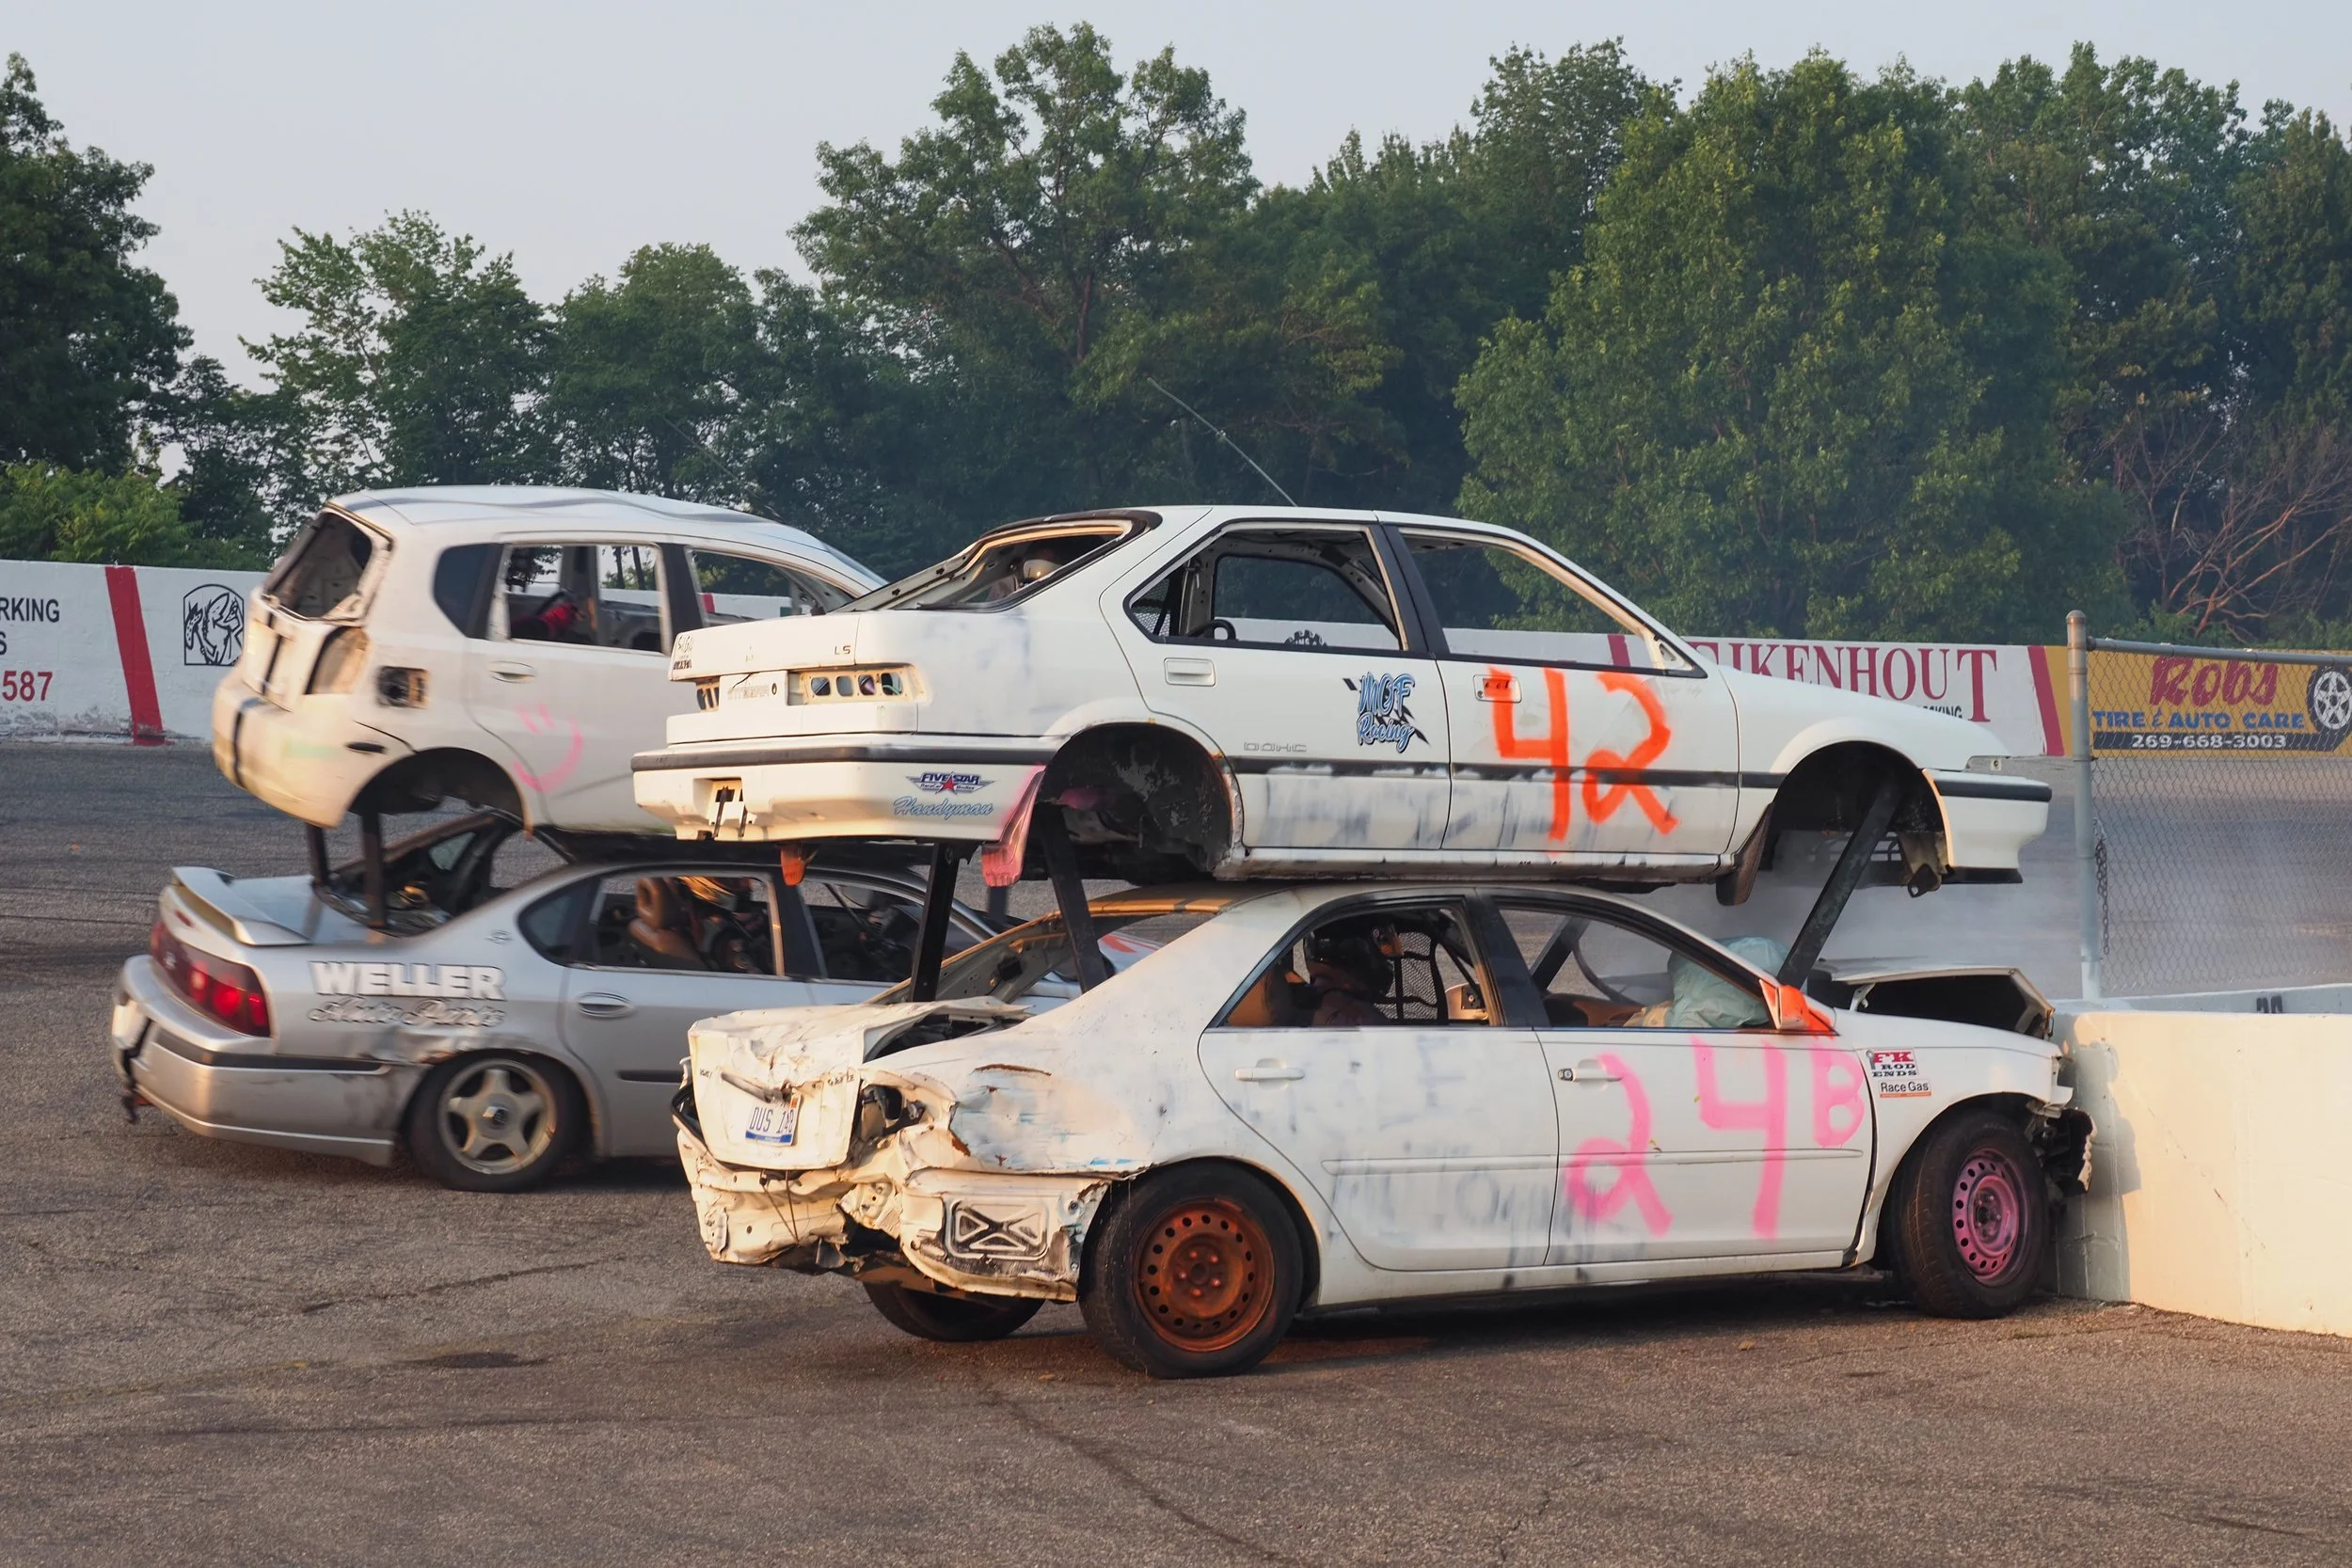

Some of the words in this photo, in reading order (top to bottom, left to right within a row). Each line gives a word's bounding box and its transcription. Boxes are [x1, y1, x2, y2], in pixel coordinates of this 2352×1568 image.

[834, 645, 851, 656] LS
[2, 670, 54, 702] 587
[2092, 710, 2146, 728] TIRE
[2169, 710, 2232, 729] AUTO
[2243, 711, 2305, 729] CARE
[1357, 711, 1416, 753] Racing
[1243, 741, 1308, 752] DOHC
[2131, 734, 2287, 749] 269-668-3003
[1487, 665, 1679, 842] 42
[921, 772, 948, 784] FIVE
[952, 774, 980, 785] STAR
[893, 795, 994, 821] Handyman
[309, 960, 508, 1002] WELLER
[1873, 1052, 1915, 1064] FK
[1871, 1069, 1917, 1078] ENDS
[1880, 1082, 1907, 1092] Race
[1908, 1081, 1930, 1092] Gas
